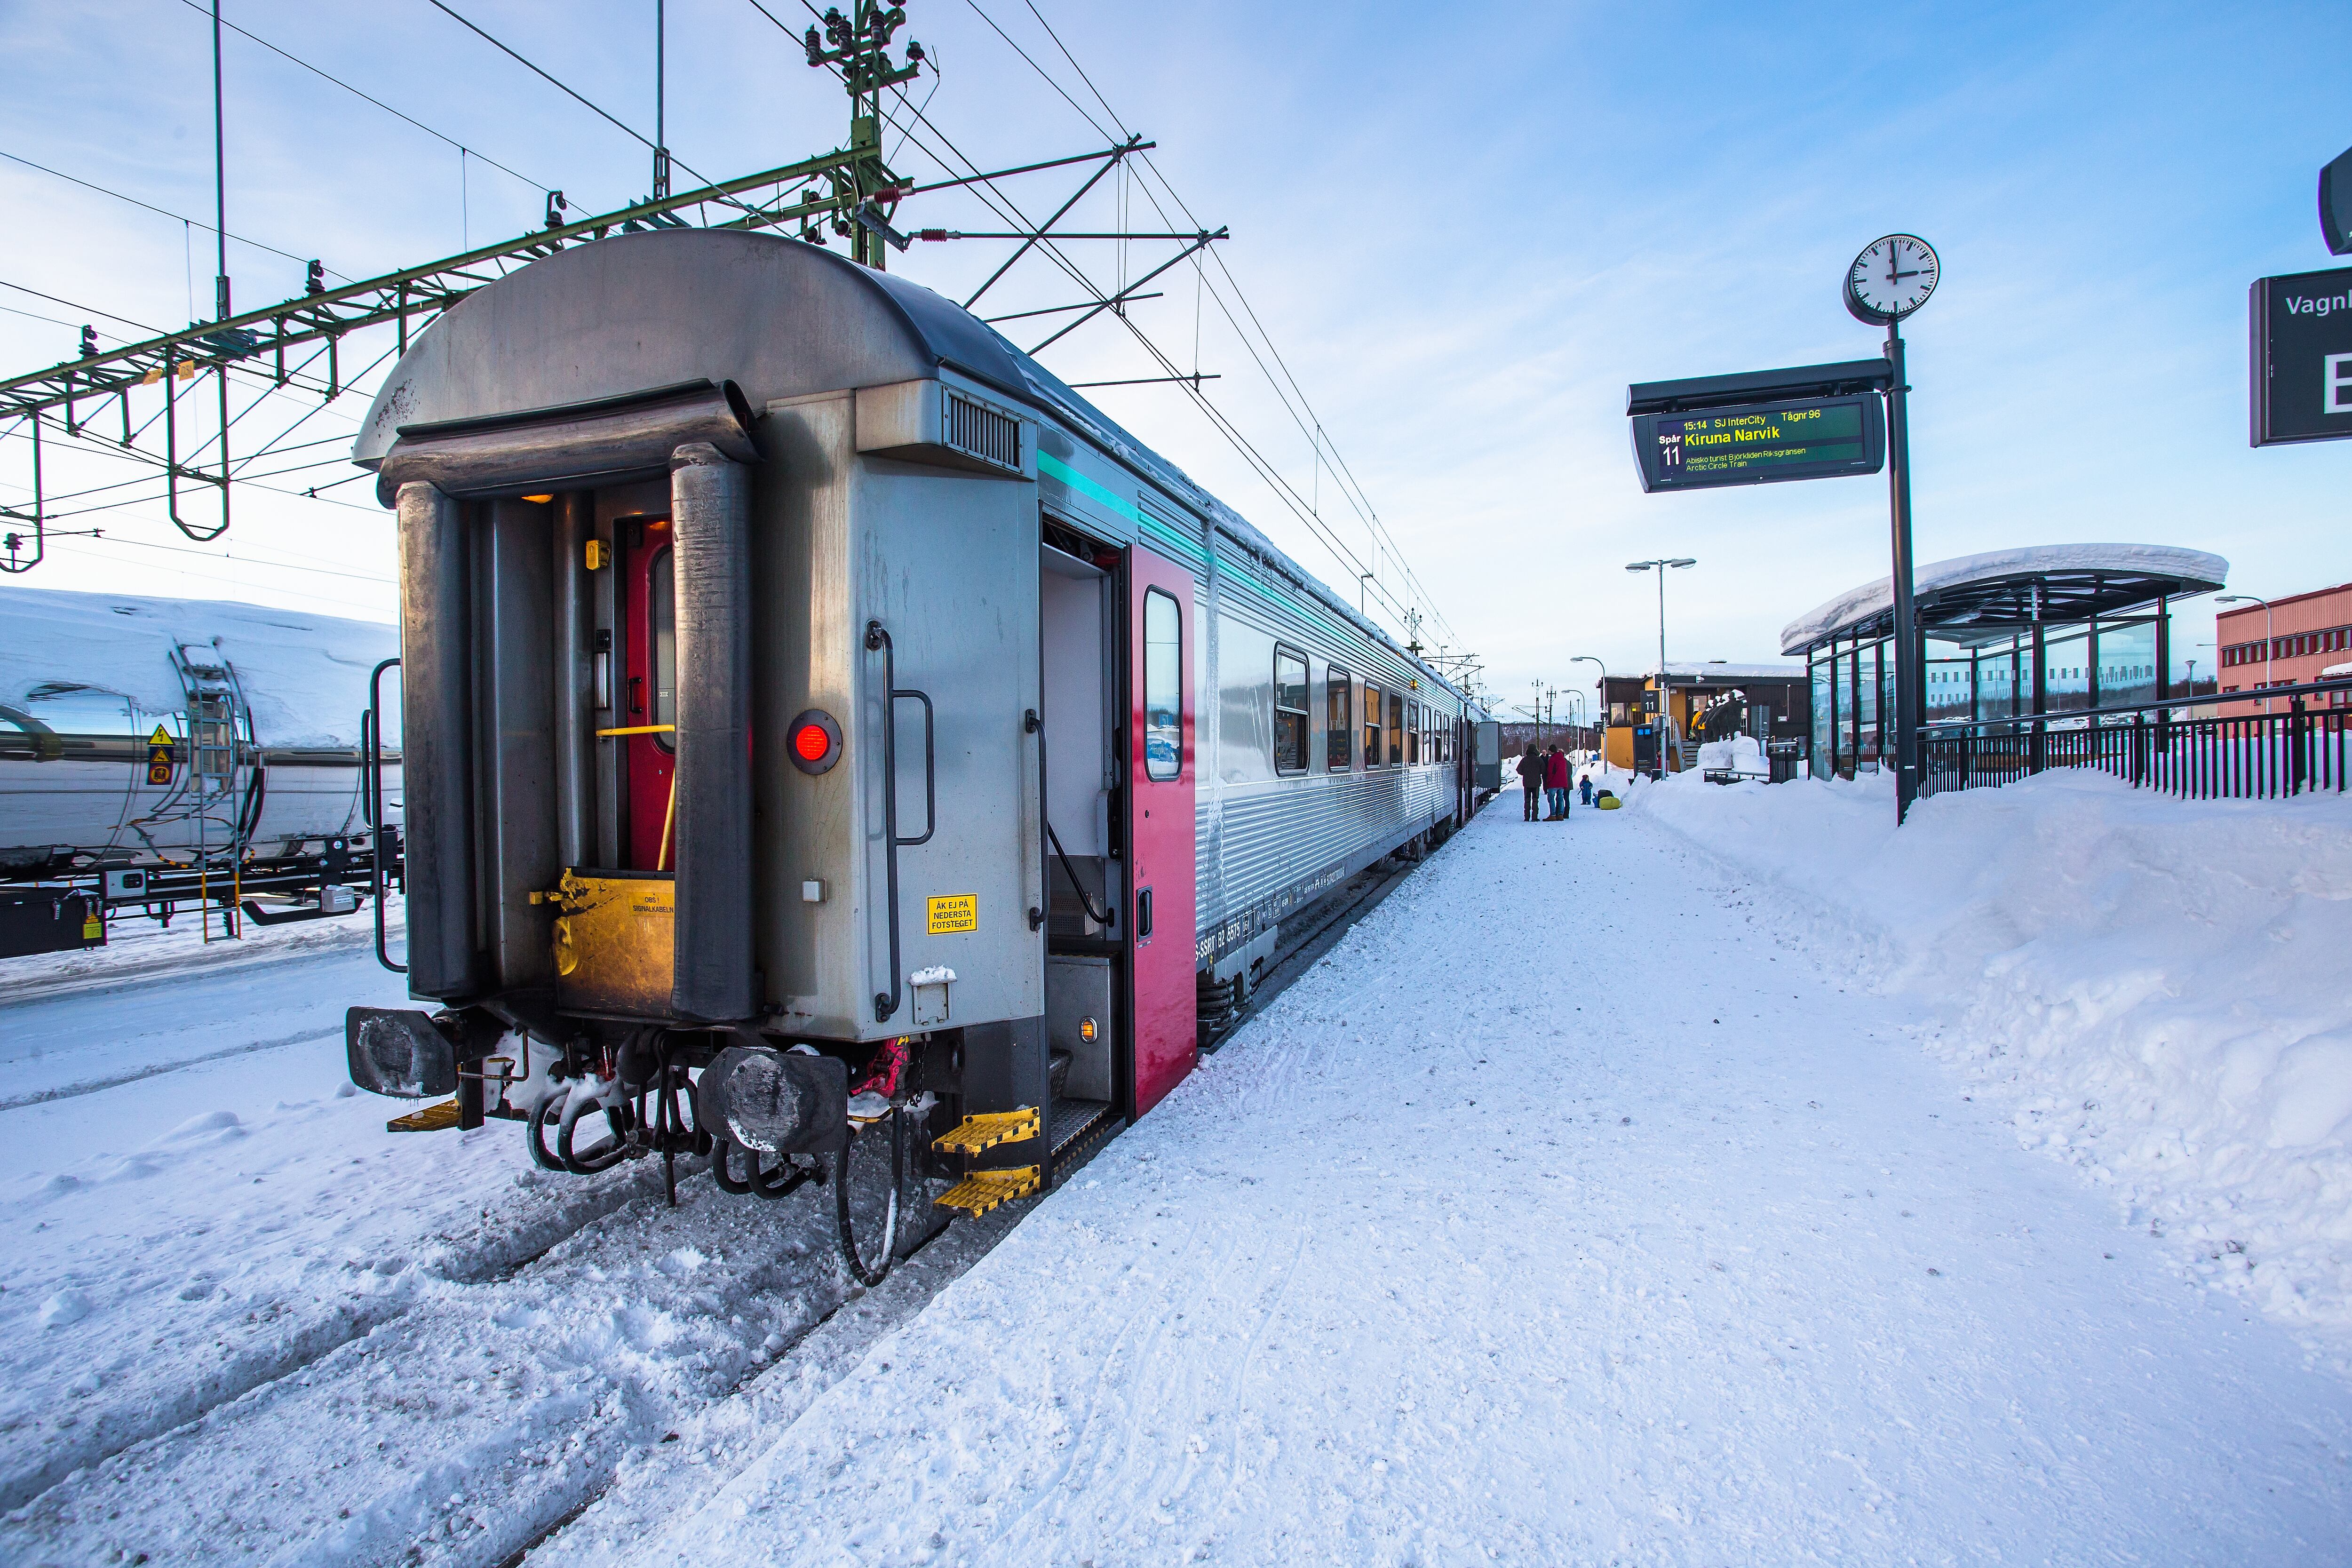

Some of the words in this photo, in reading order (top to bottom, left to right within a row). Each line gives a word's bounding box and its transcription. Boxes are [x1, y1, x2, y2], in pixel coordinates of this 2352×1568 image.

[1684, 420, 1707, 430] 15:14
[1715, 418, 1726, 428] SJ
[1728, 416, 1766, 427] InterCity
[1781, 411, 1807, 422] Tågnr
[1809, 410, 1820, 419] 96
[1659, 434, 1681, 446] Spår
[1685, 433, 1731, 446] Kiruna
[1735, 426, 1780, 442] Narvik
[1663, 446, 1679, 466] 11
[1729, 452, 1762, 462] Björkliden
[1764, 448, 1805, 457] Riksgränsen
[1645, 701, 1653, 710] 11
[936, 900, 946, 909] ÅK
[959, 899, 968, 908] PÅ
[934, 910, 971, 919] NEDERSTA
[932, 919, 973, 929] FOTSTEGET
[1218, 930, 1225, 948] B2
